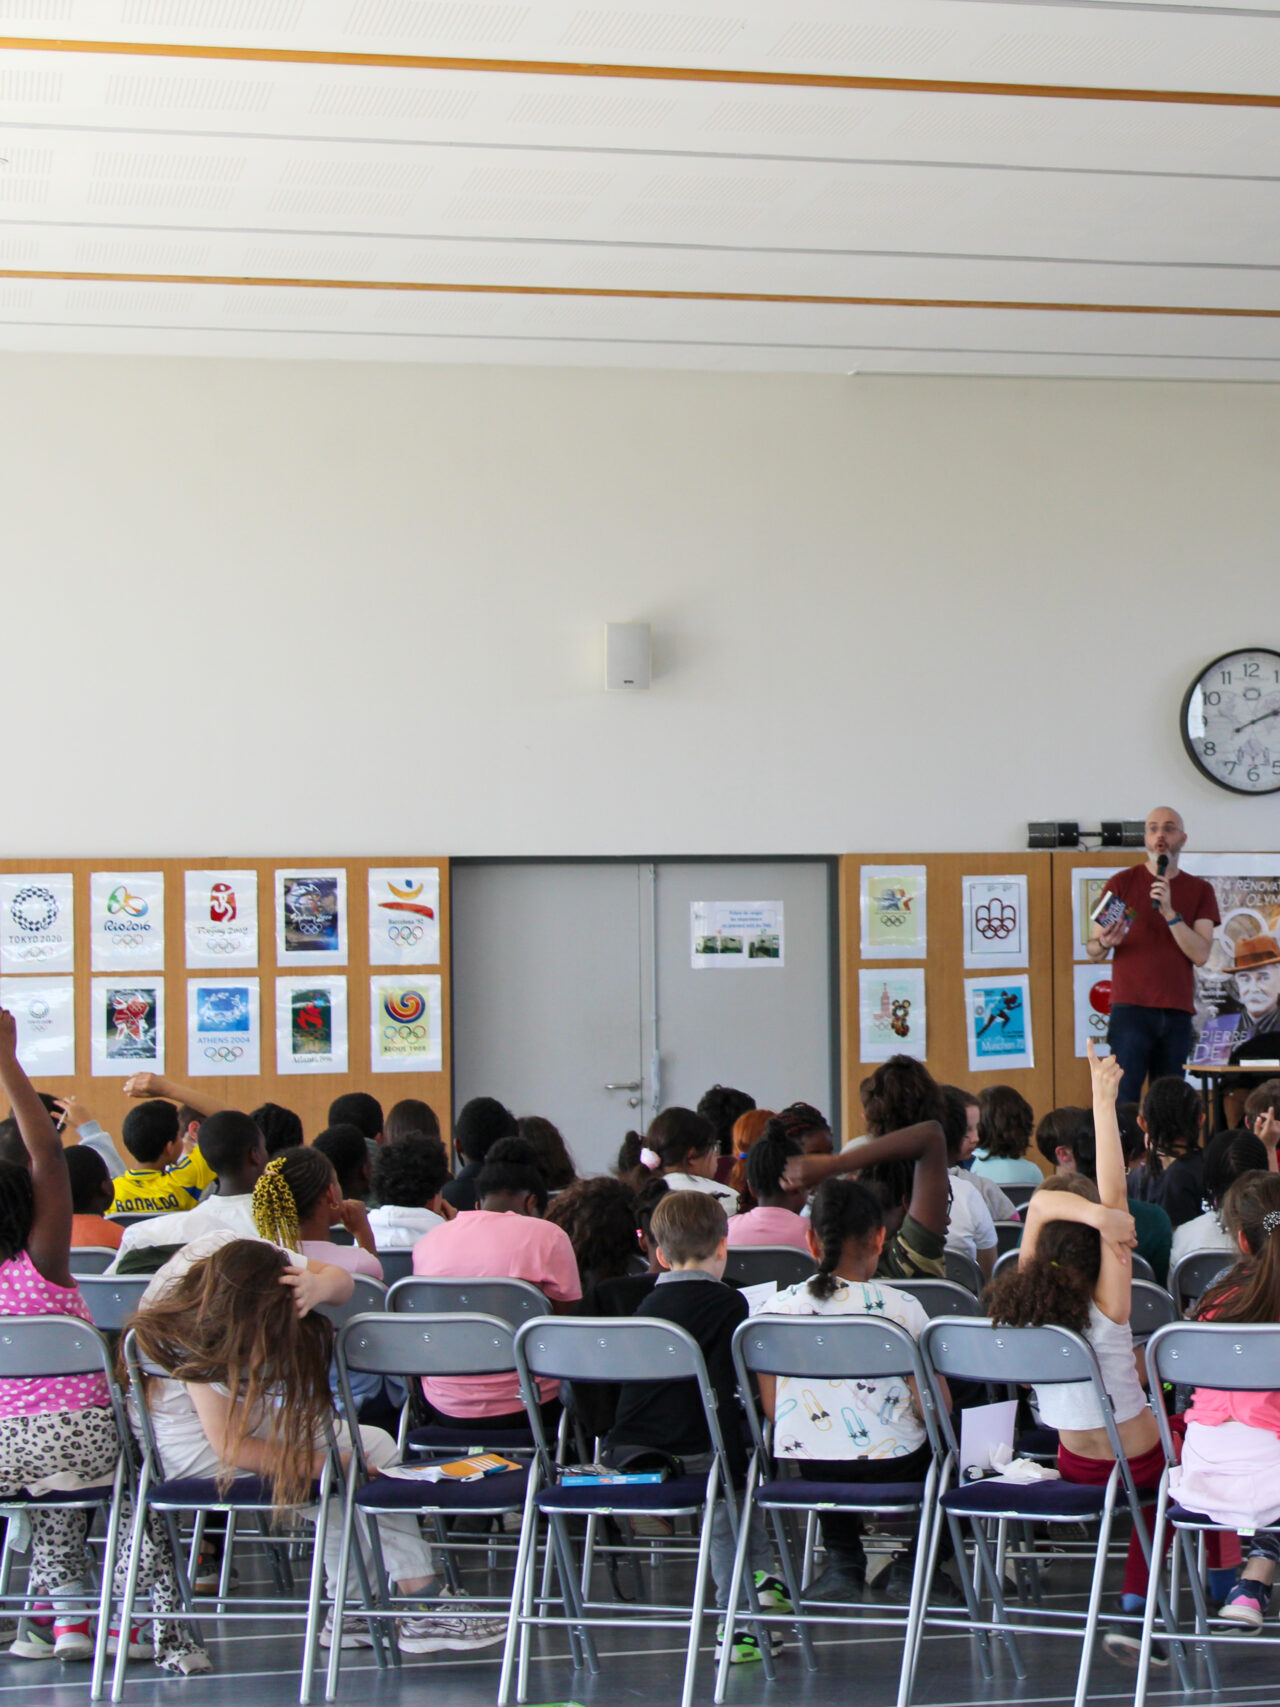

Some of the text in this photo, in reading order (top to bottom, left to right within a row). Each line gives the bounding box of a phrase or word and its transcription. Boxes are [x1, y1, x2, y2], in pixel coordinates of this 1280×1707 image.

[1243, 662, 1260, 678] 12
[1274, 670, 1280, 684] 1
[1220, 671, 1232, 685] 11
[1202, 691, 1221, 706] 10
[1203, 741, 1216, 756] 8
[1224, 760, 1237, 776] 7
[1247, 765, 1260, 782] 6
[8, 935, 63, 944] TOKYO 2020
[197, 1036, 250, 1044] ATHENS 2004
[1199, 1029, 1248, 1043] PIERRE
[115, 1193, 179, 1212] RONALDO
